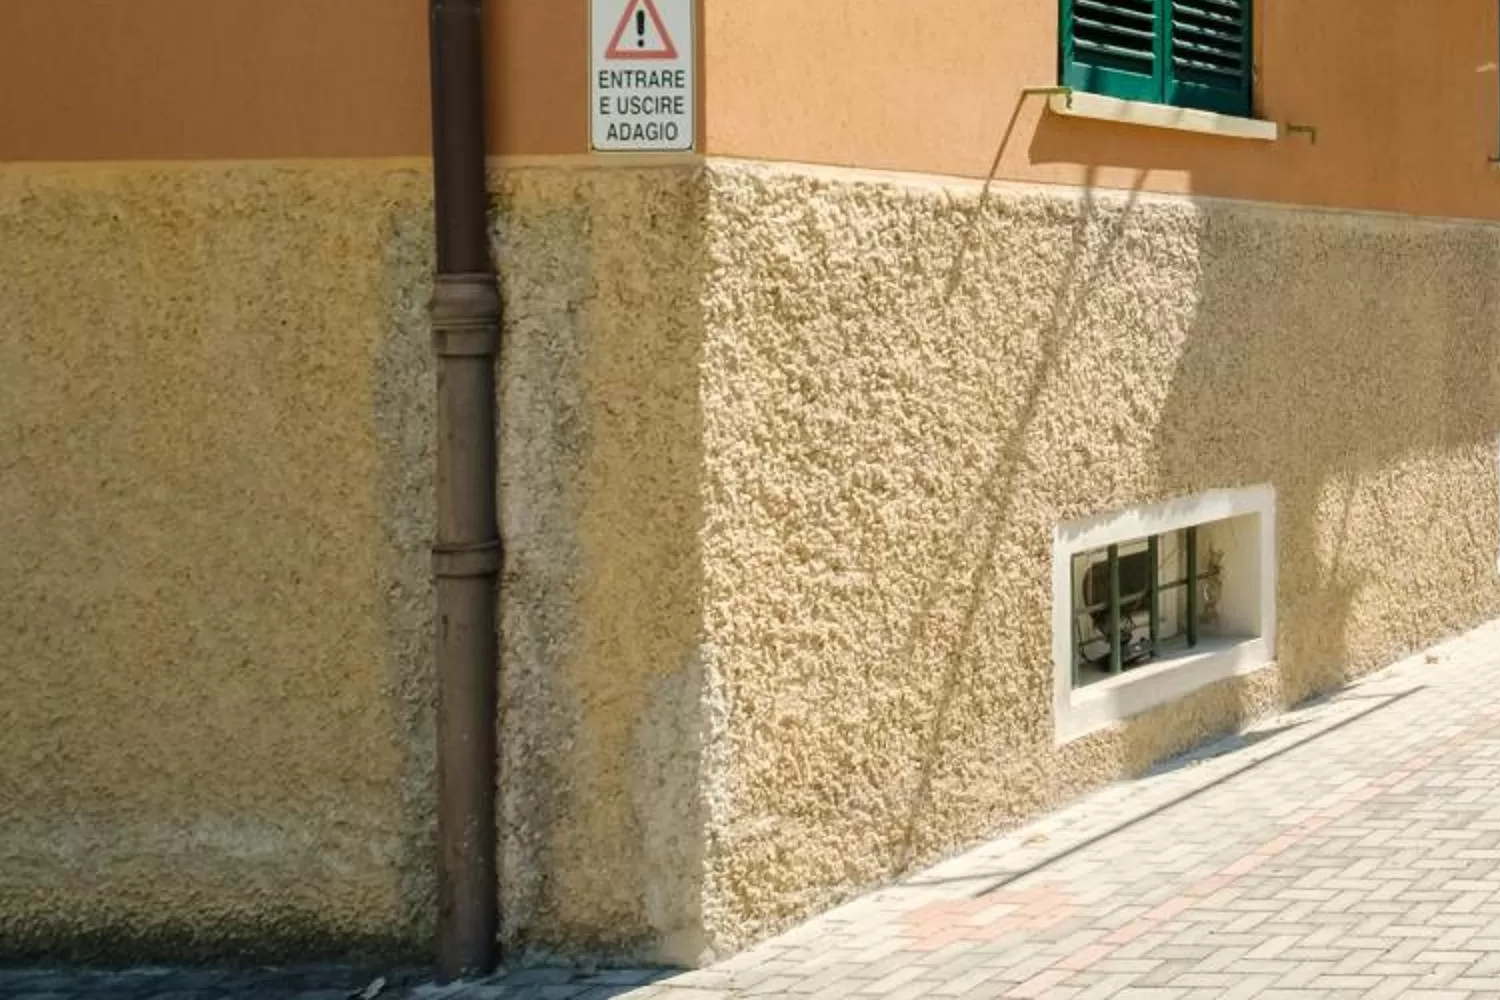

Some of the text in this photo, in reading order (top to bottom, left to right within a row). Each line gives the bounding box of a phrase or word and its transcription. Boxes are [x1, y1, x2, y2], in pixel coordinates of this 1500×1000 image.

[599, 70, 685, 89] ENTRARE
[600, 96, 685, 115] E USCIRE
[606, 122, 679, 141] ADAGIO
